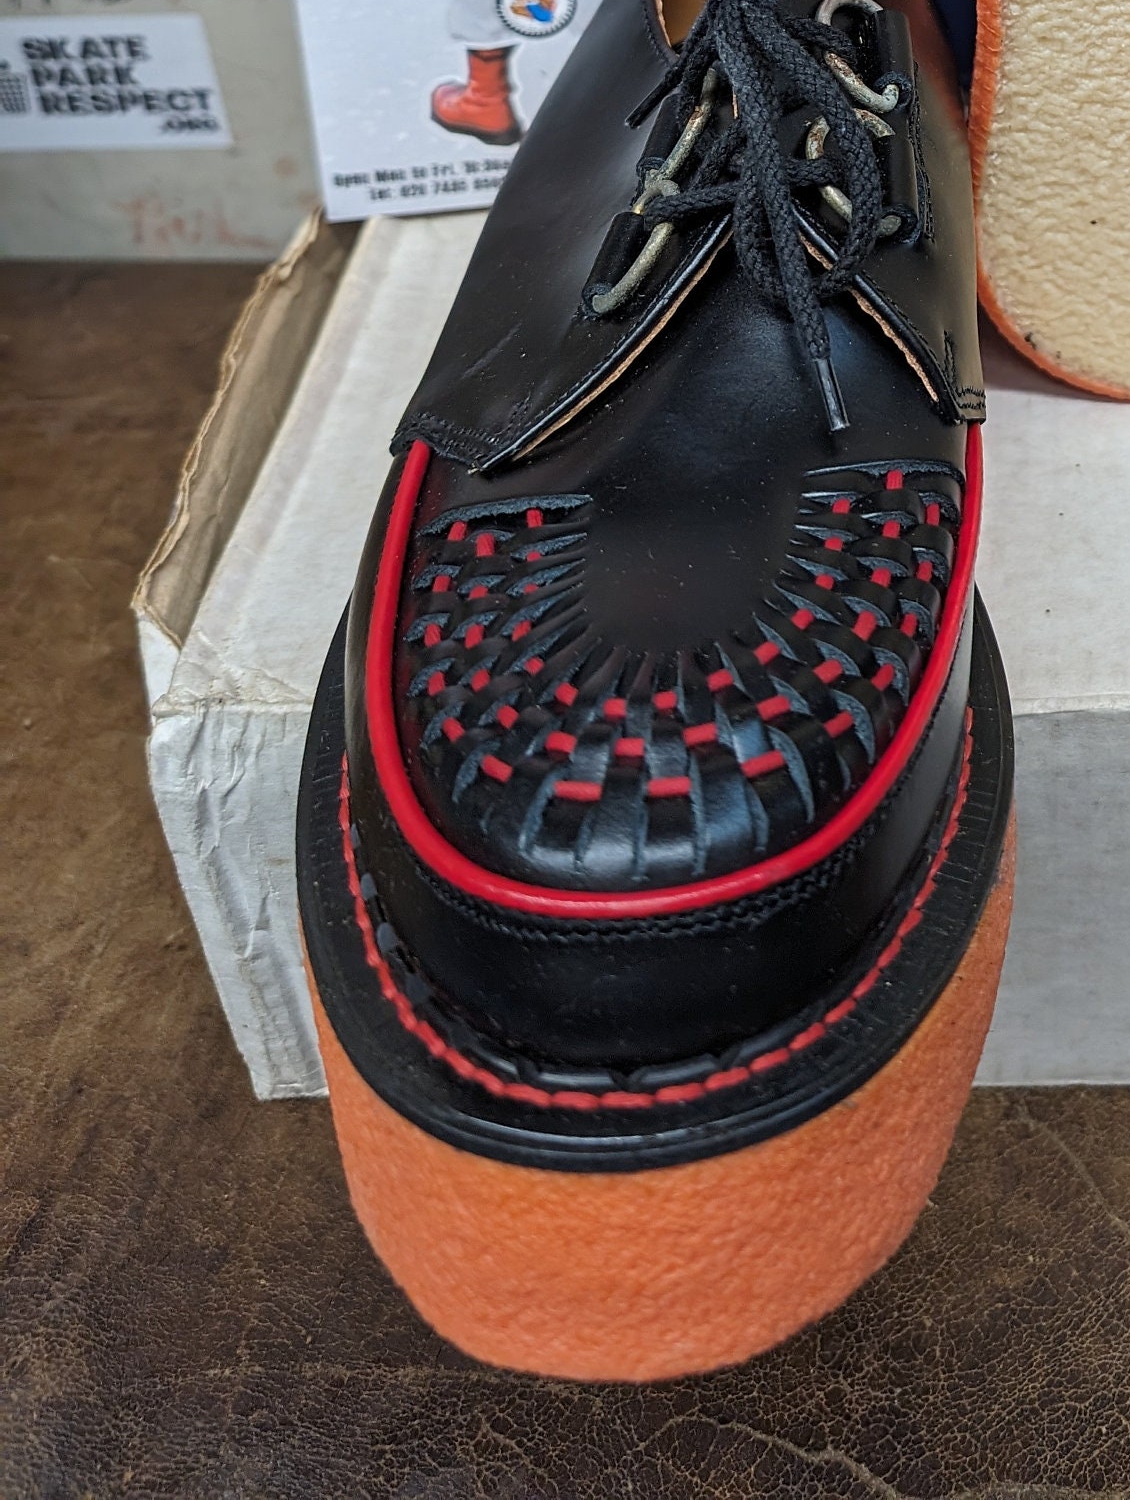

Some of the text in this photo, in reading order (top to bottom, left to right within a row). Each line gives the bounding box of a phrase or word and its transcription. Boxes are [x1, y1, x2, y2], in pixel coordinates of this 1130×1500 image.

[22, 36, 149, 61] SKATE
[30, 64, 139, 87] PARK
[39, 88, 212, 114] RESPECT
